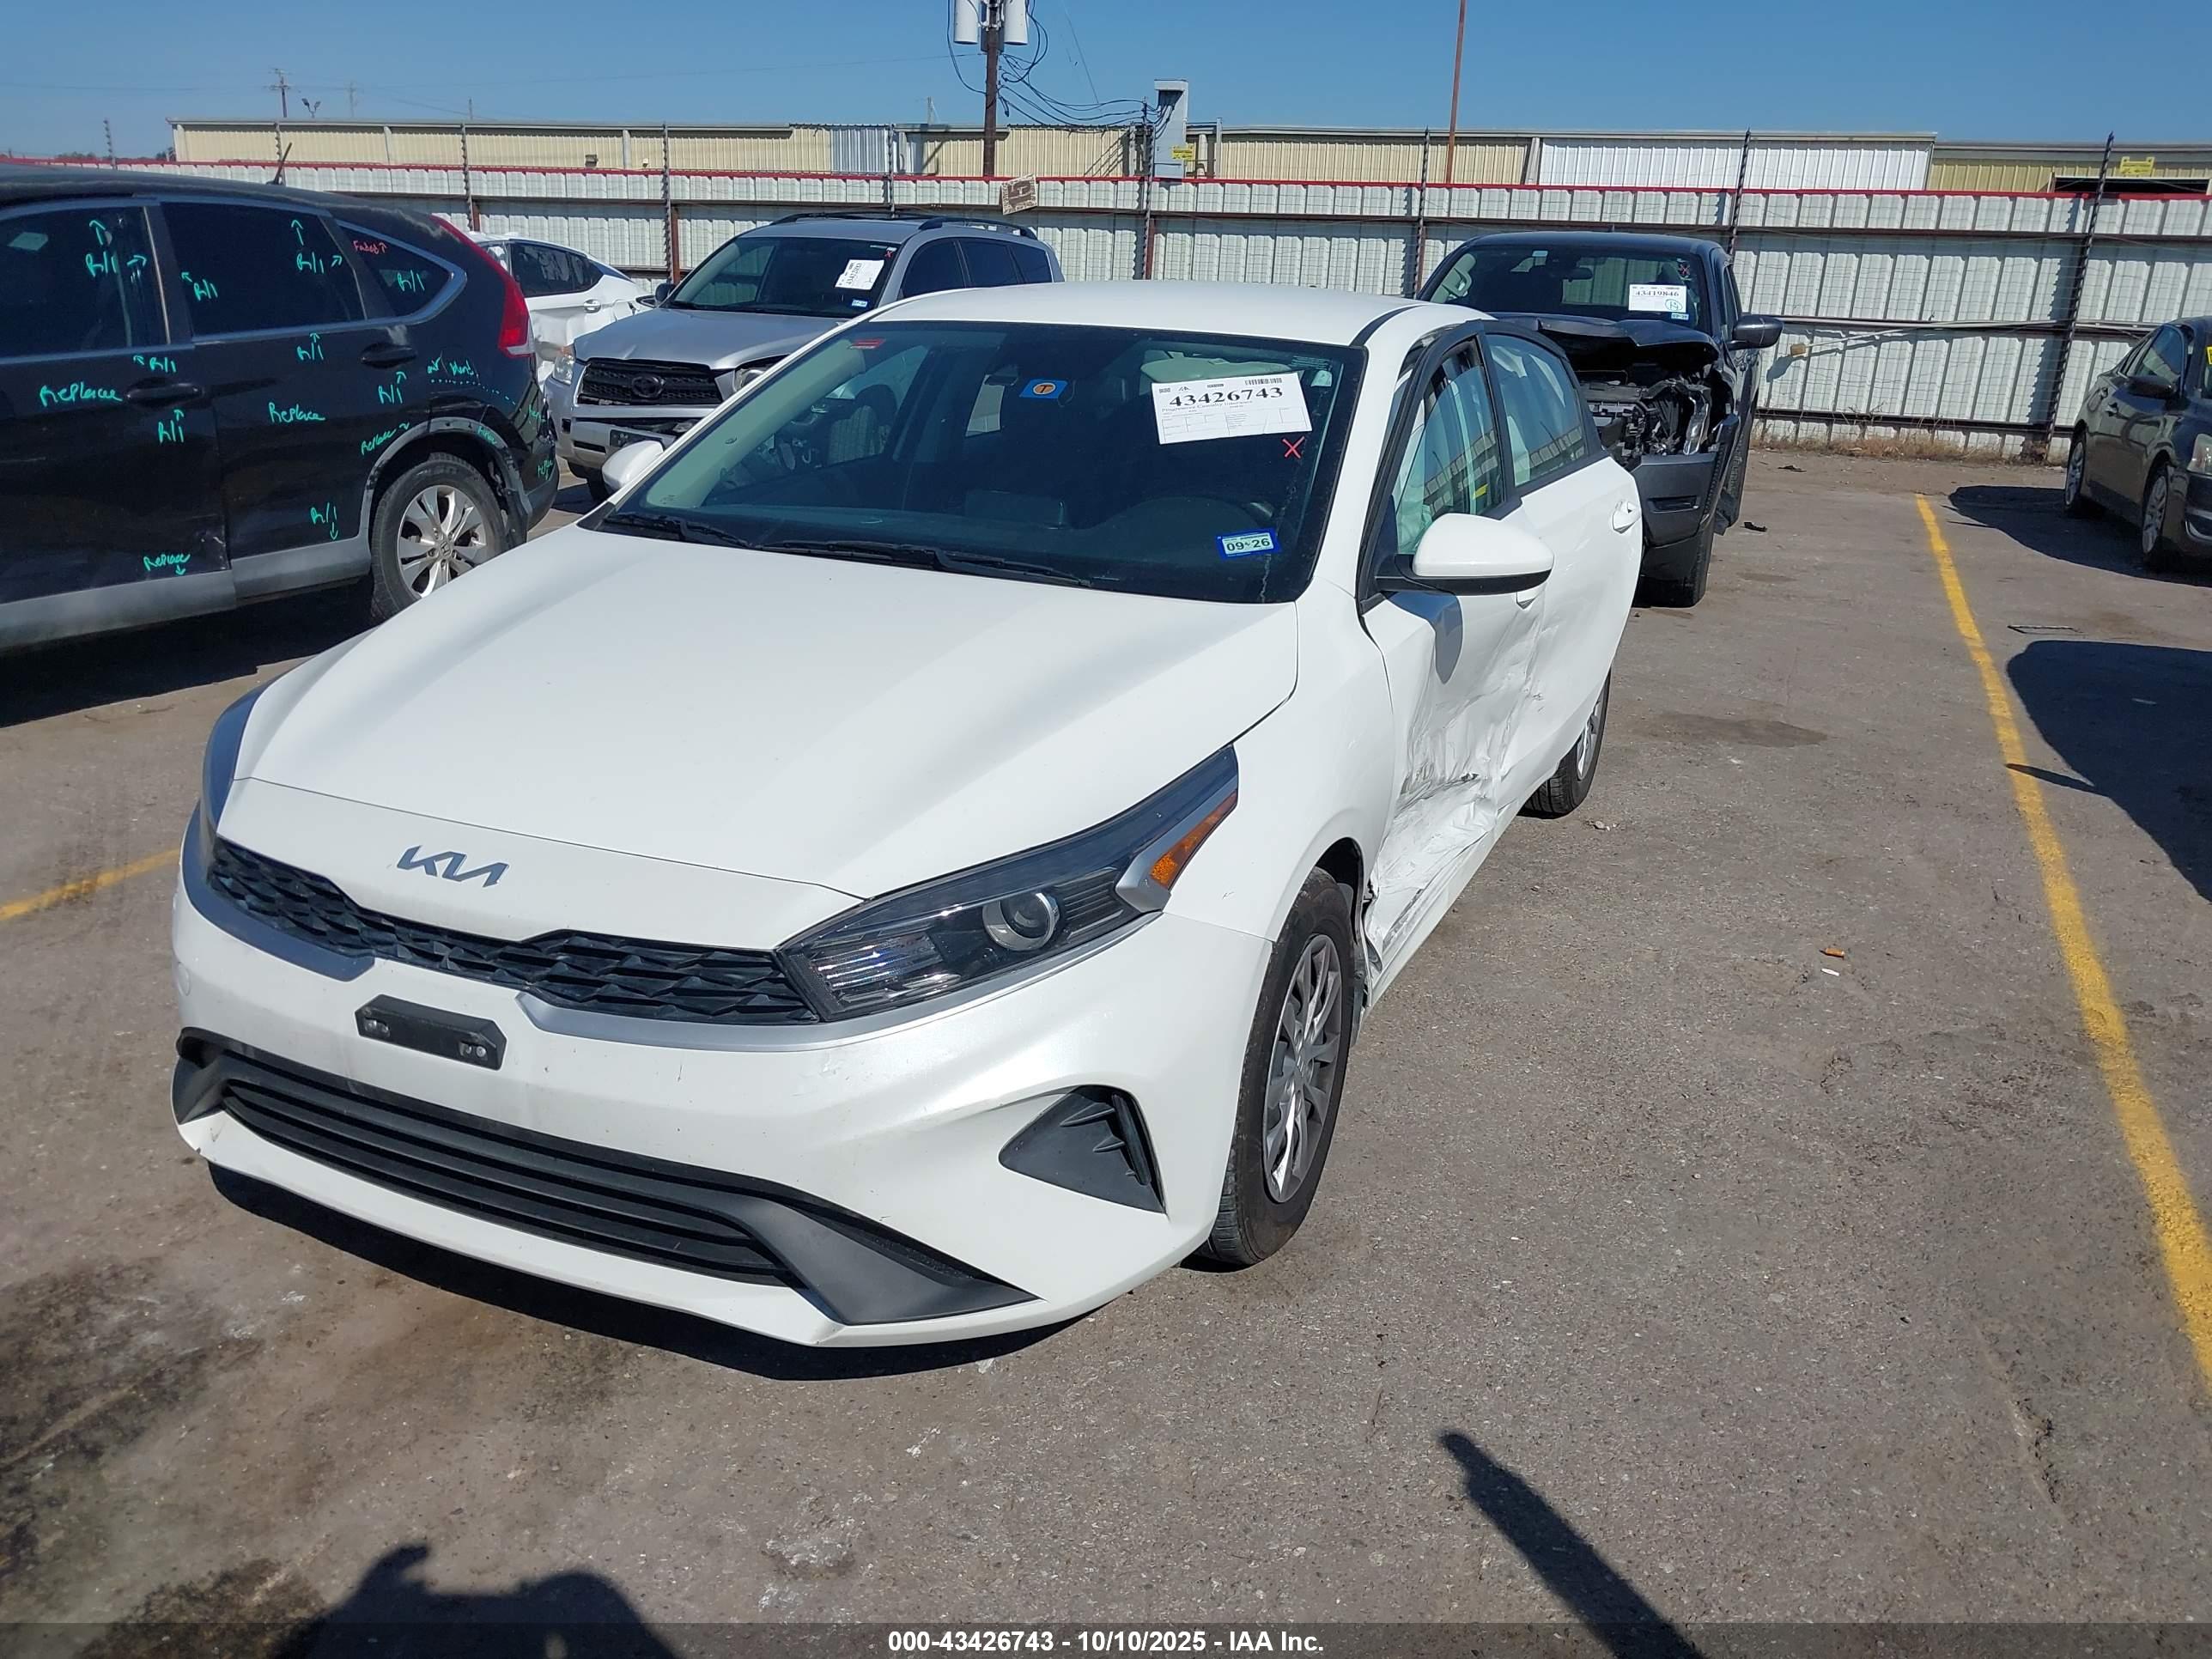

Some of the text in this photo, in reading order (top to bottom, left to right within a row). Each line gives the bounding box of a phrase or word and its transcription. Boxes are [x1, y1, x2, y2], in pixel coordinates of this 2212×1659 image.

[1170, 387, 1283, 406] 43426743
[1226, 538, 1271, 551] 09 26
[397, 845, 509, 888] KIA
